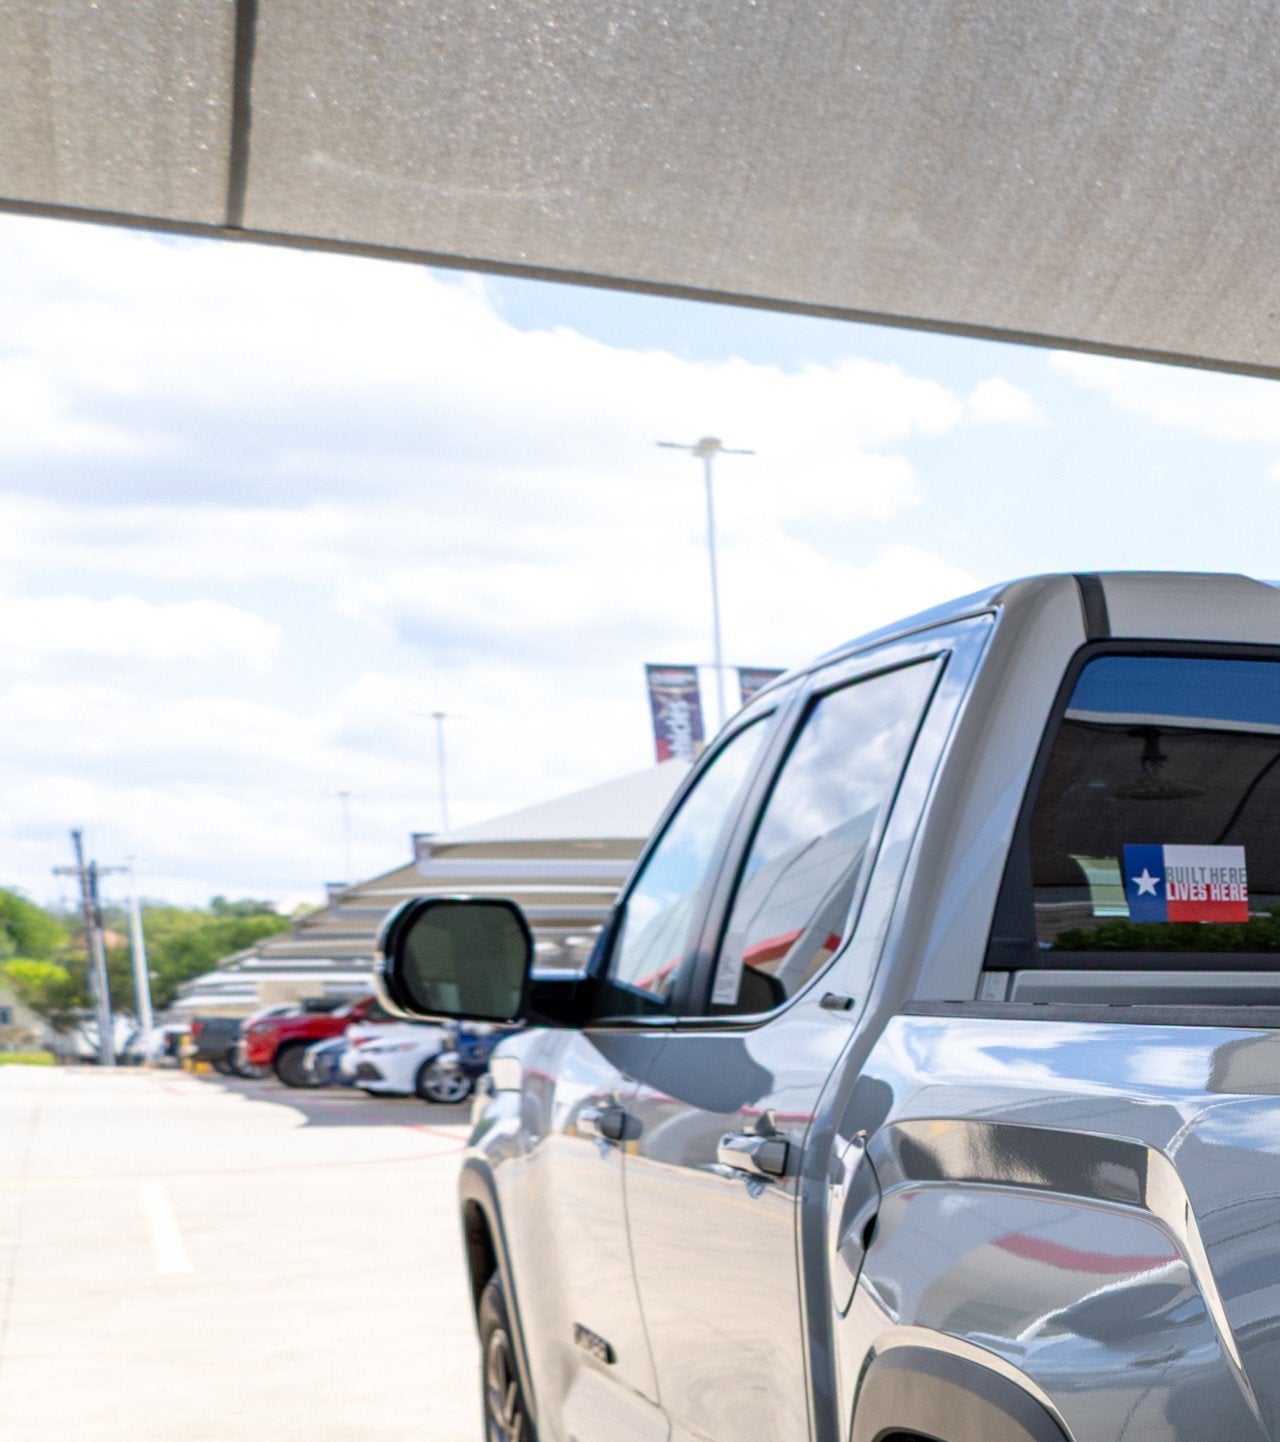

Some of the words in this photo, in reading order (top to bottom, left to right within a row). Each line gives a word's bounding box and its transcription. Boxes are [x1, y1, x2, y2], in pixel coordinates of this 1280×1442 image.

[1166, 866, 1207, 884] BUILT
[1210, 867, 1247, 884] HERE
[1166, 883, 1208, 901] LIVES
[1210, 883, 1248, 901] HERE
